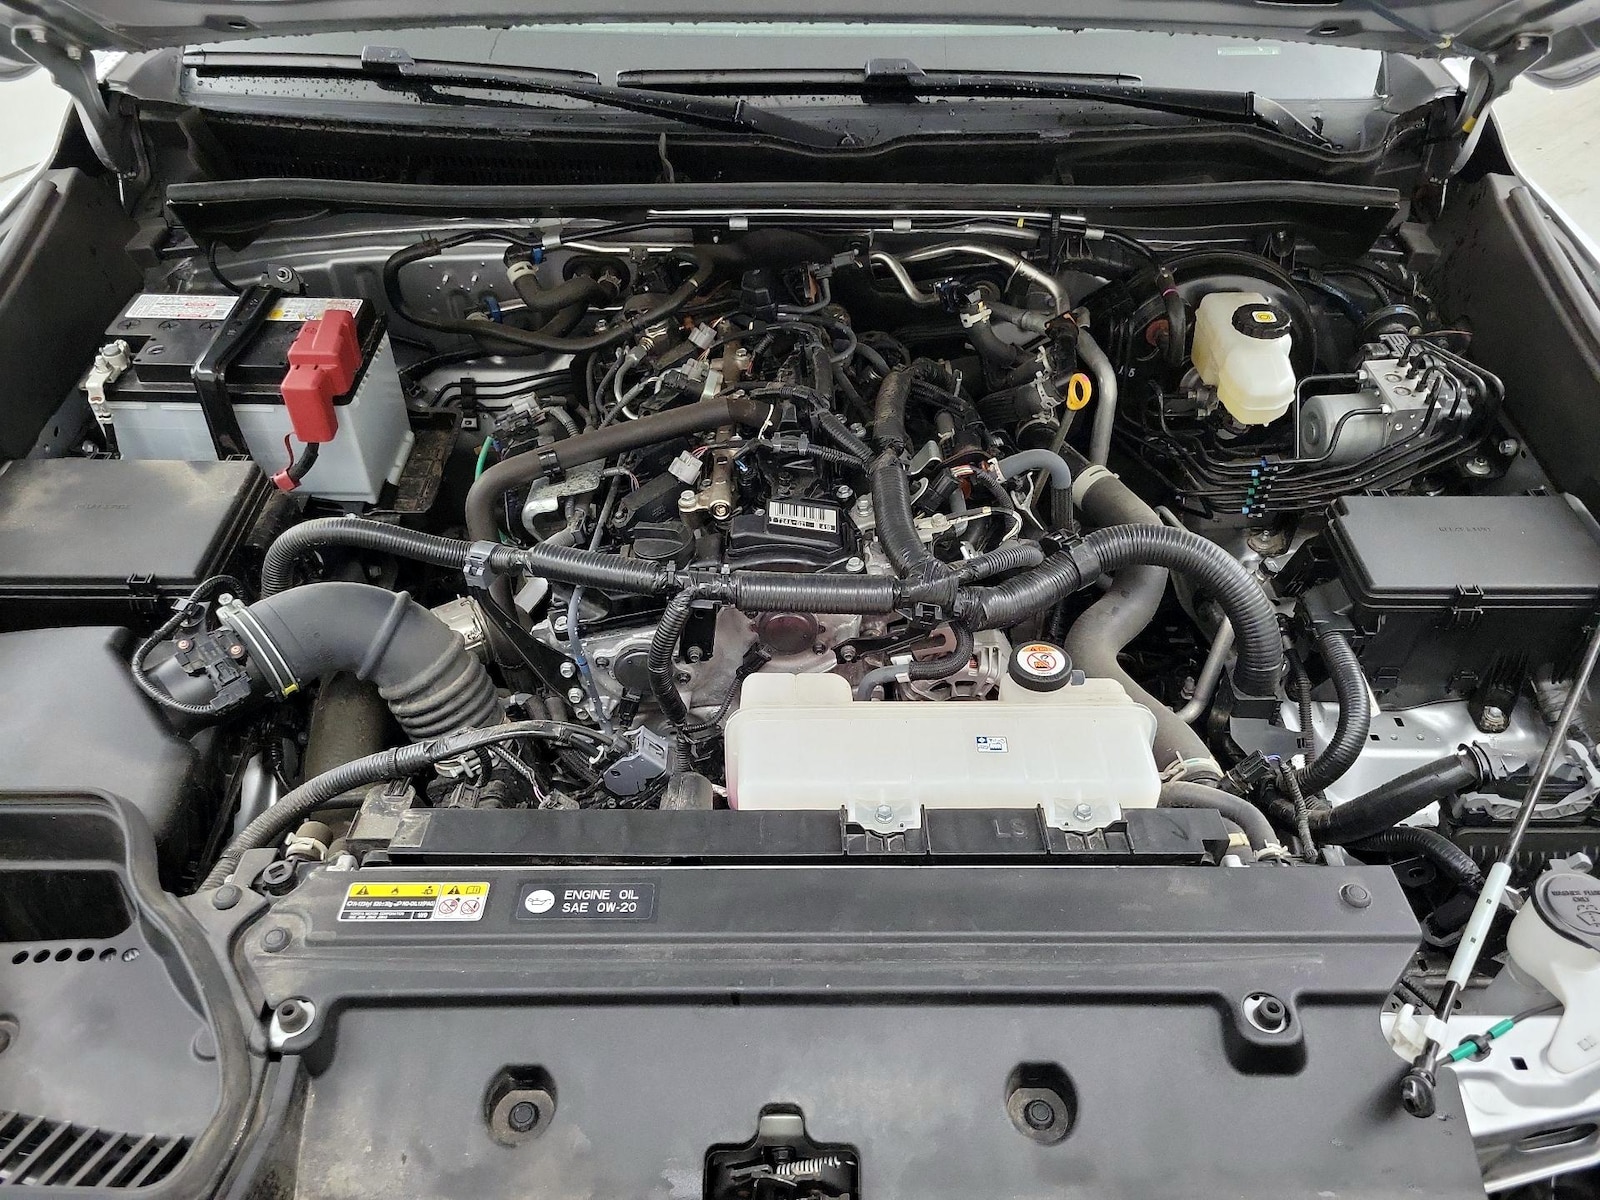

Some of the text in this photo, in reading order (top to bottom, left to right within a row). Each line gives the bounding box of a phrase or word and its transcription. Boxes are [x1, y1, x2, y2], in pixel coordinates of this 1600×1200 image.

[563, 889, 639, 900] ENGINE OIL
[561, 902, 637, 913] SAE 0W-20
